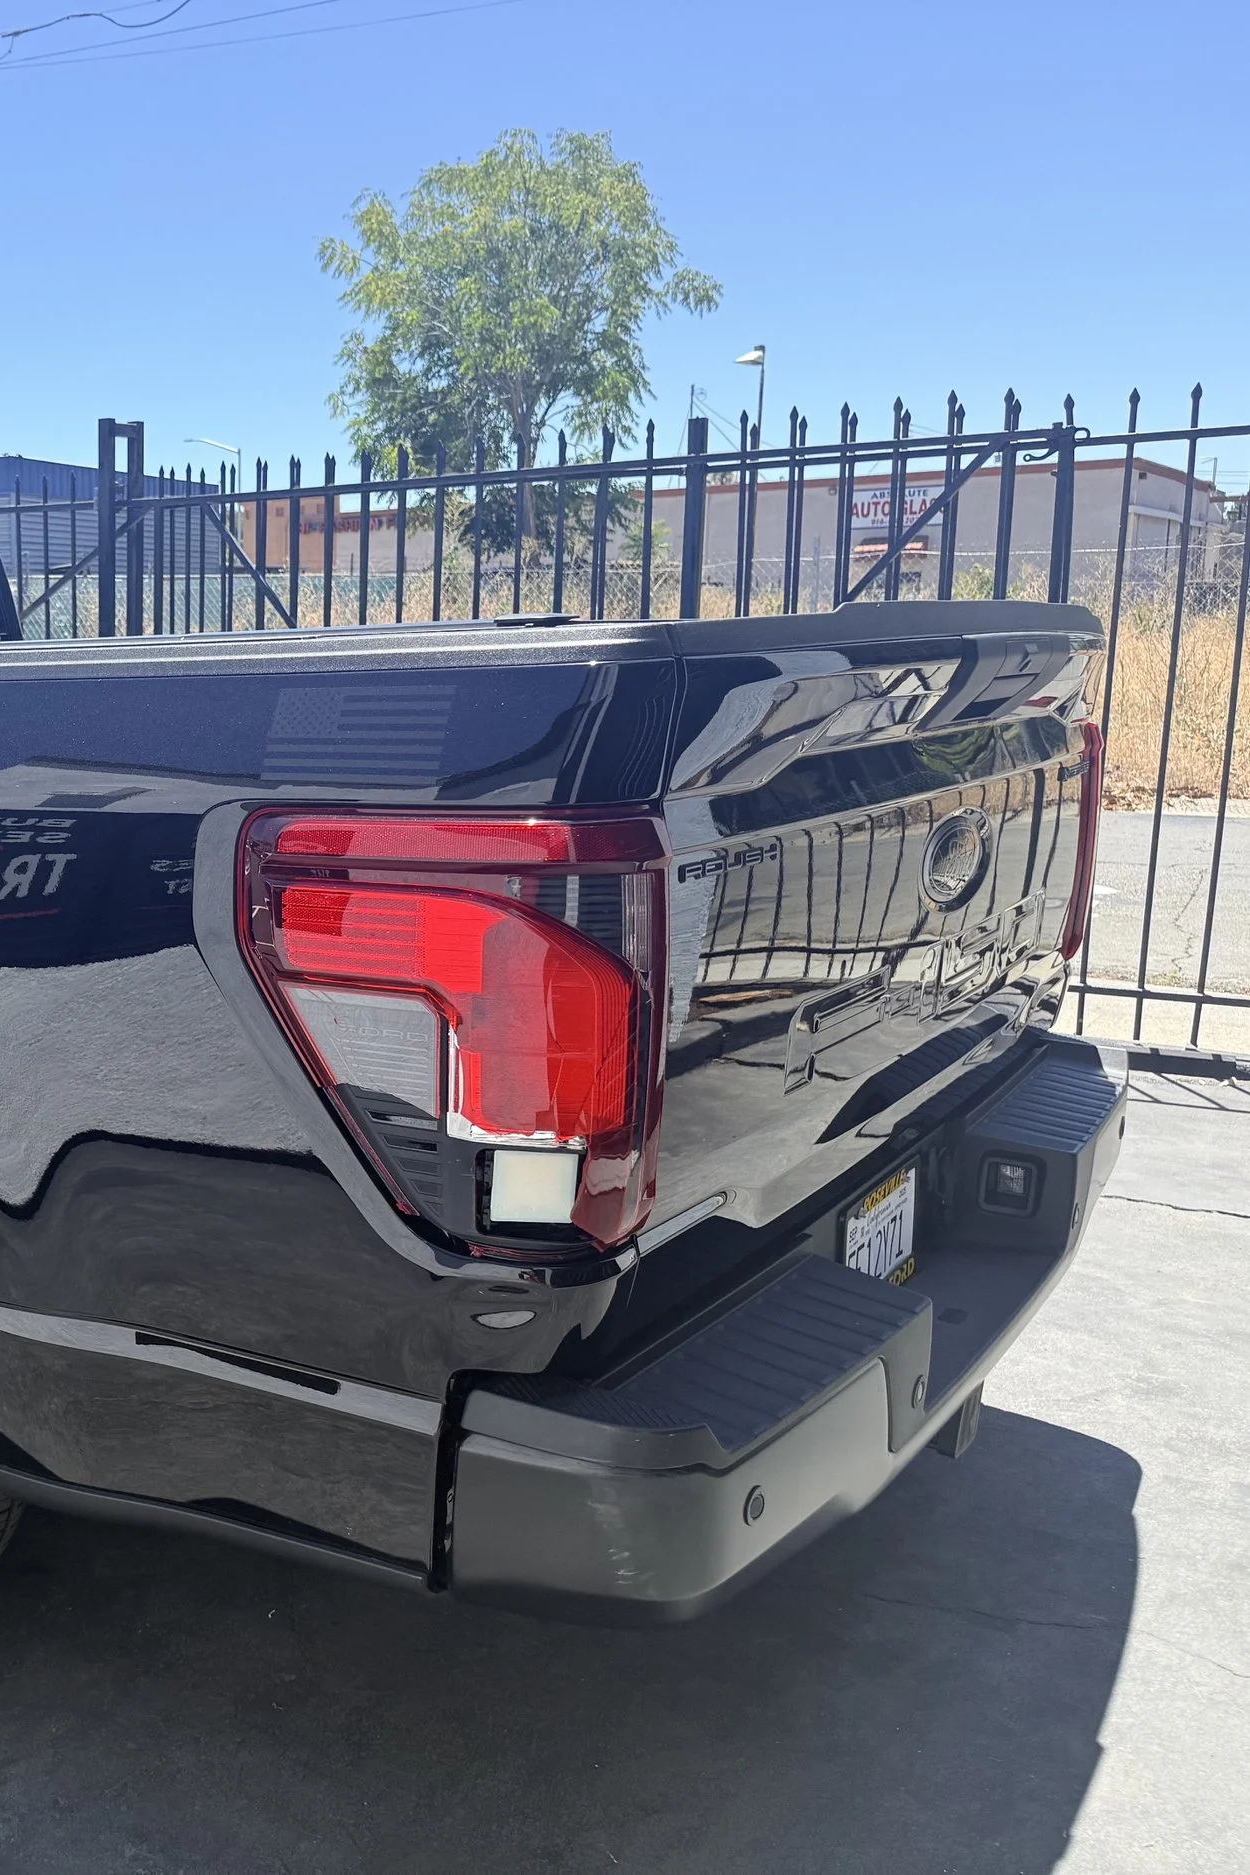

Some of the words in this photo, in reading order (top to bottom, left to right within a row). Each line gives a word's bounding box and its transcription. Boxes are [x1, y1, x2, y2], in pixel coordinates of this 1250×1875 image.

[871, 488, 929, 499] ABSUTE
[852, 501, 890, 518] AUTO
[902, 497, 944, 516] GLA
[847, 1209, 904, 1278] 12Y71
